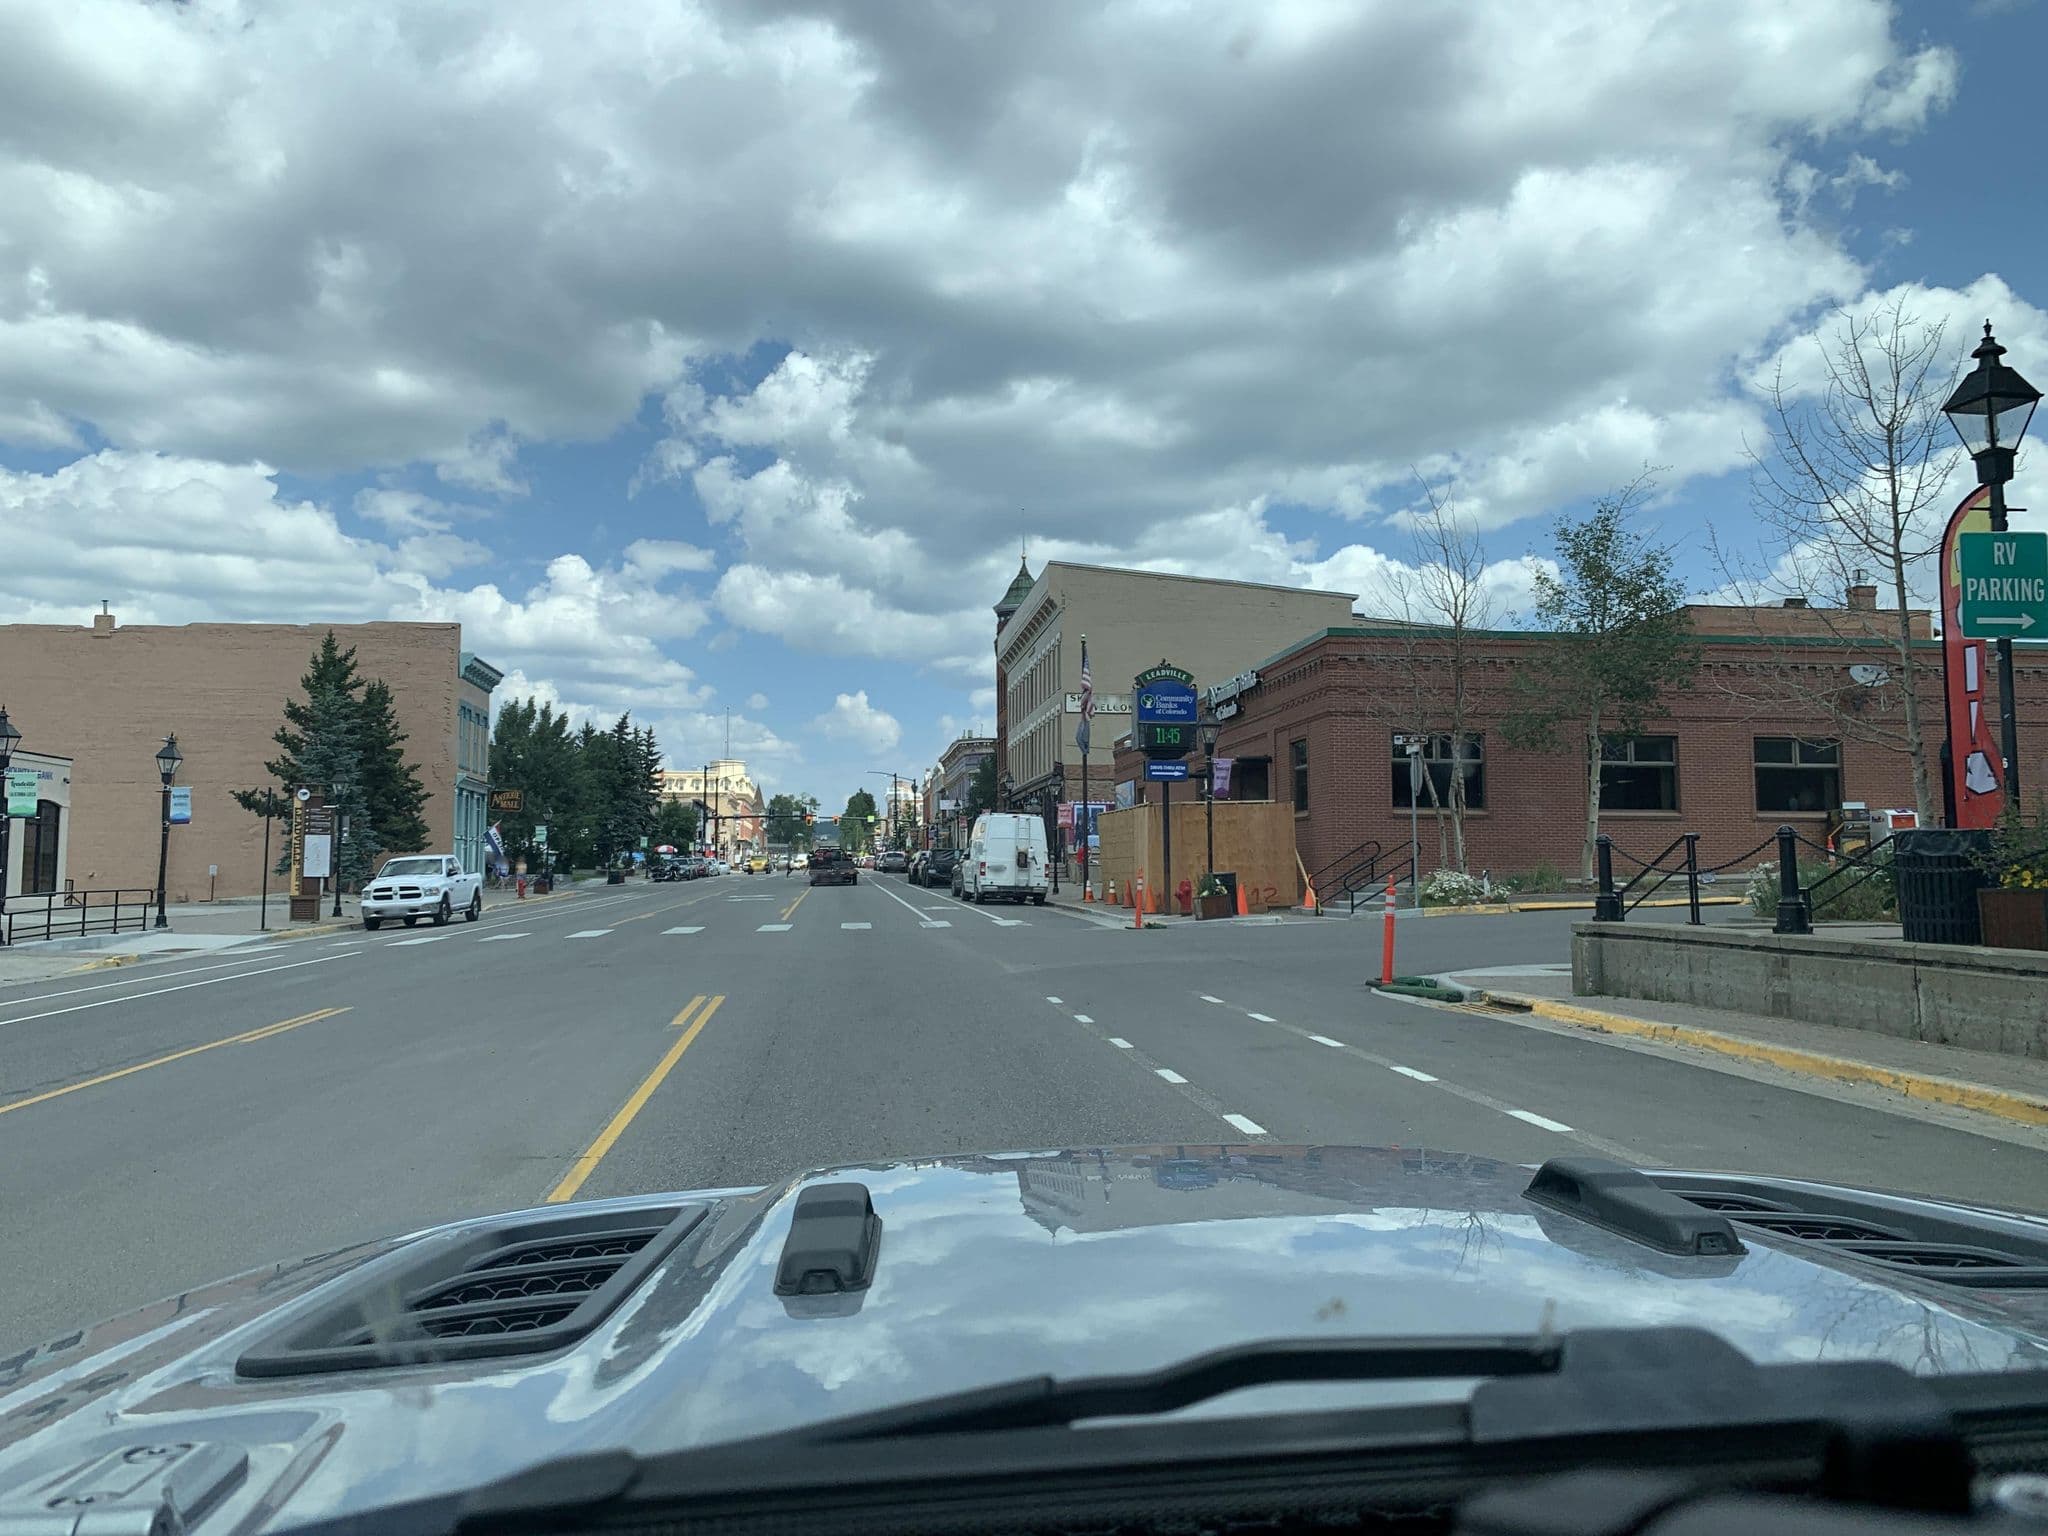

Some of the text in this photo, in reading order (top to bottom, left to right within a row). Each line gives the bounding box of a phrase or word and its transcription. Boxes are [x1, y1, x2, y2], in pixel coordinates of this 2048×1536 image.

[1993, 542, 2016, 565] RV
[1966, 578, 2045, 602] PARKING
[1145, 669, 1188, 680] LEADVILLE
[1155, 694, 1194, 704] Community
[1156, 727, 1181, 744] 11:45
